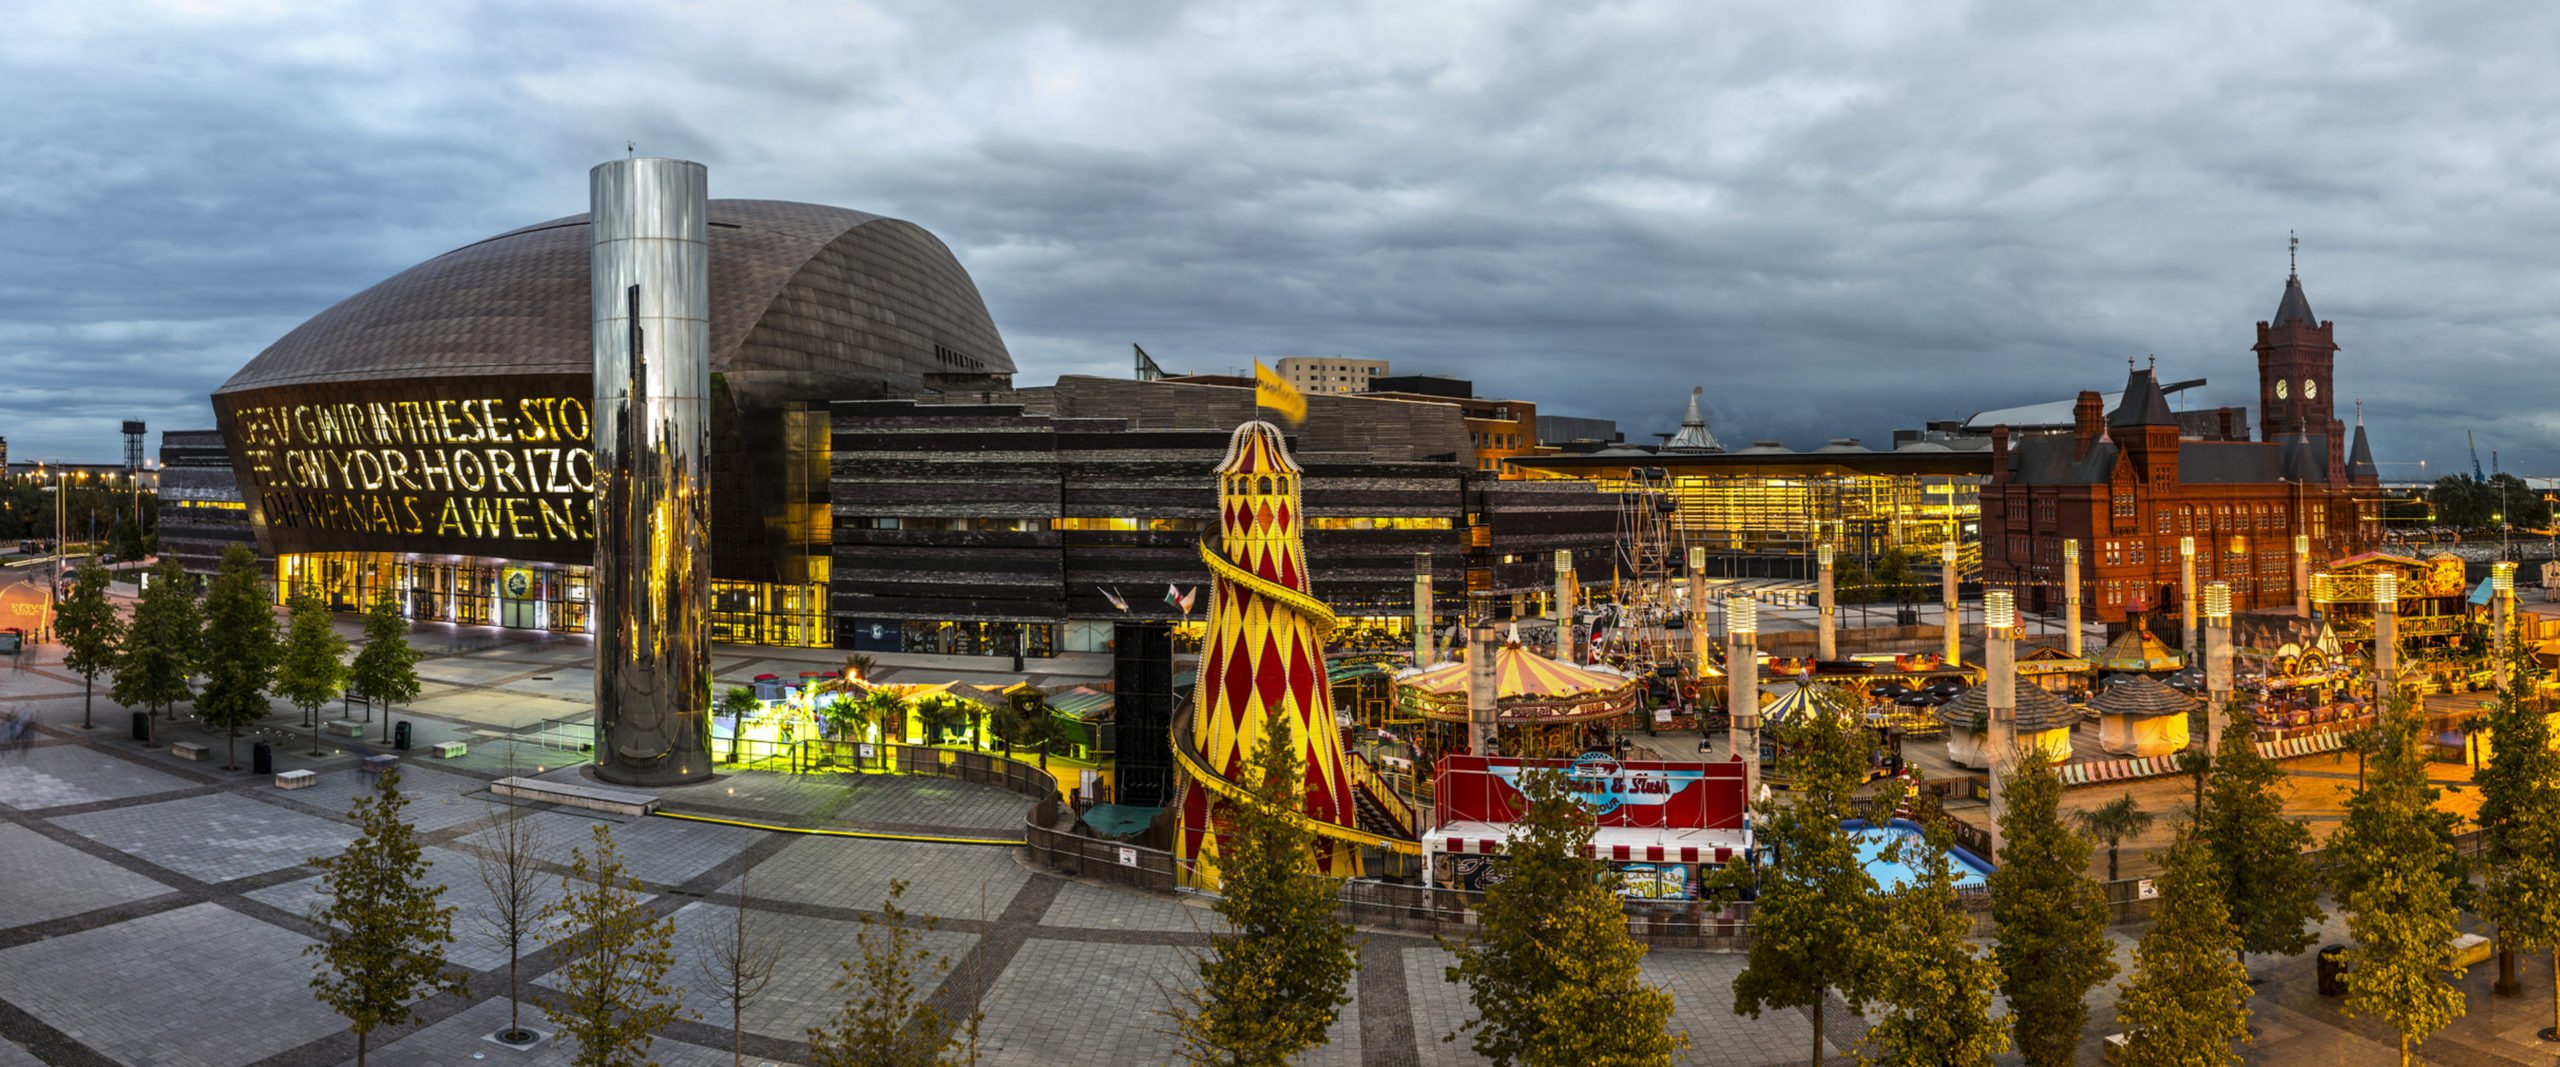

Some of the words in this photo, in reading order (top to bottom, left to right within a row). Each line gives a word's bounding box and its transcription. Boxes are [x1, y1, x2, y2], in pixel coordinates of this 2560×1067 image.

[518, 397, 595, 442] STO
[286, 449, 422, 491] GWYDR
[437, 496, 578, 541] AWEN
[1575, 796, 1620, 813] PAOUR
[1611, 775, 1626, 794] &
[1628, 773, 1670, 794] Slush
